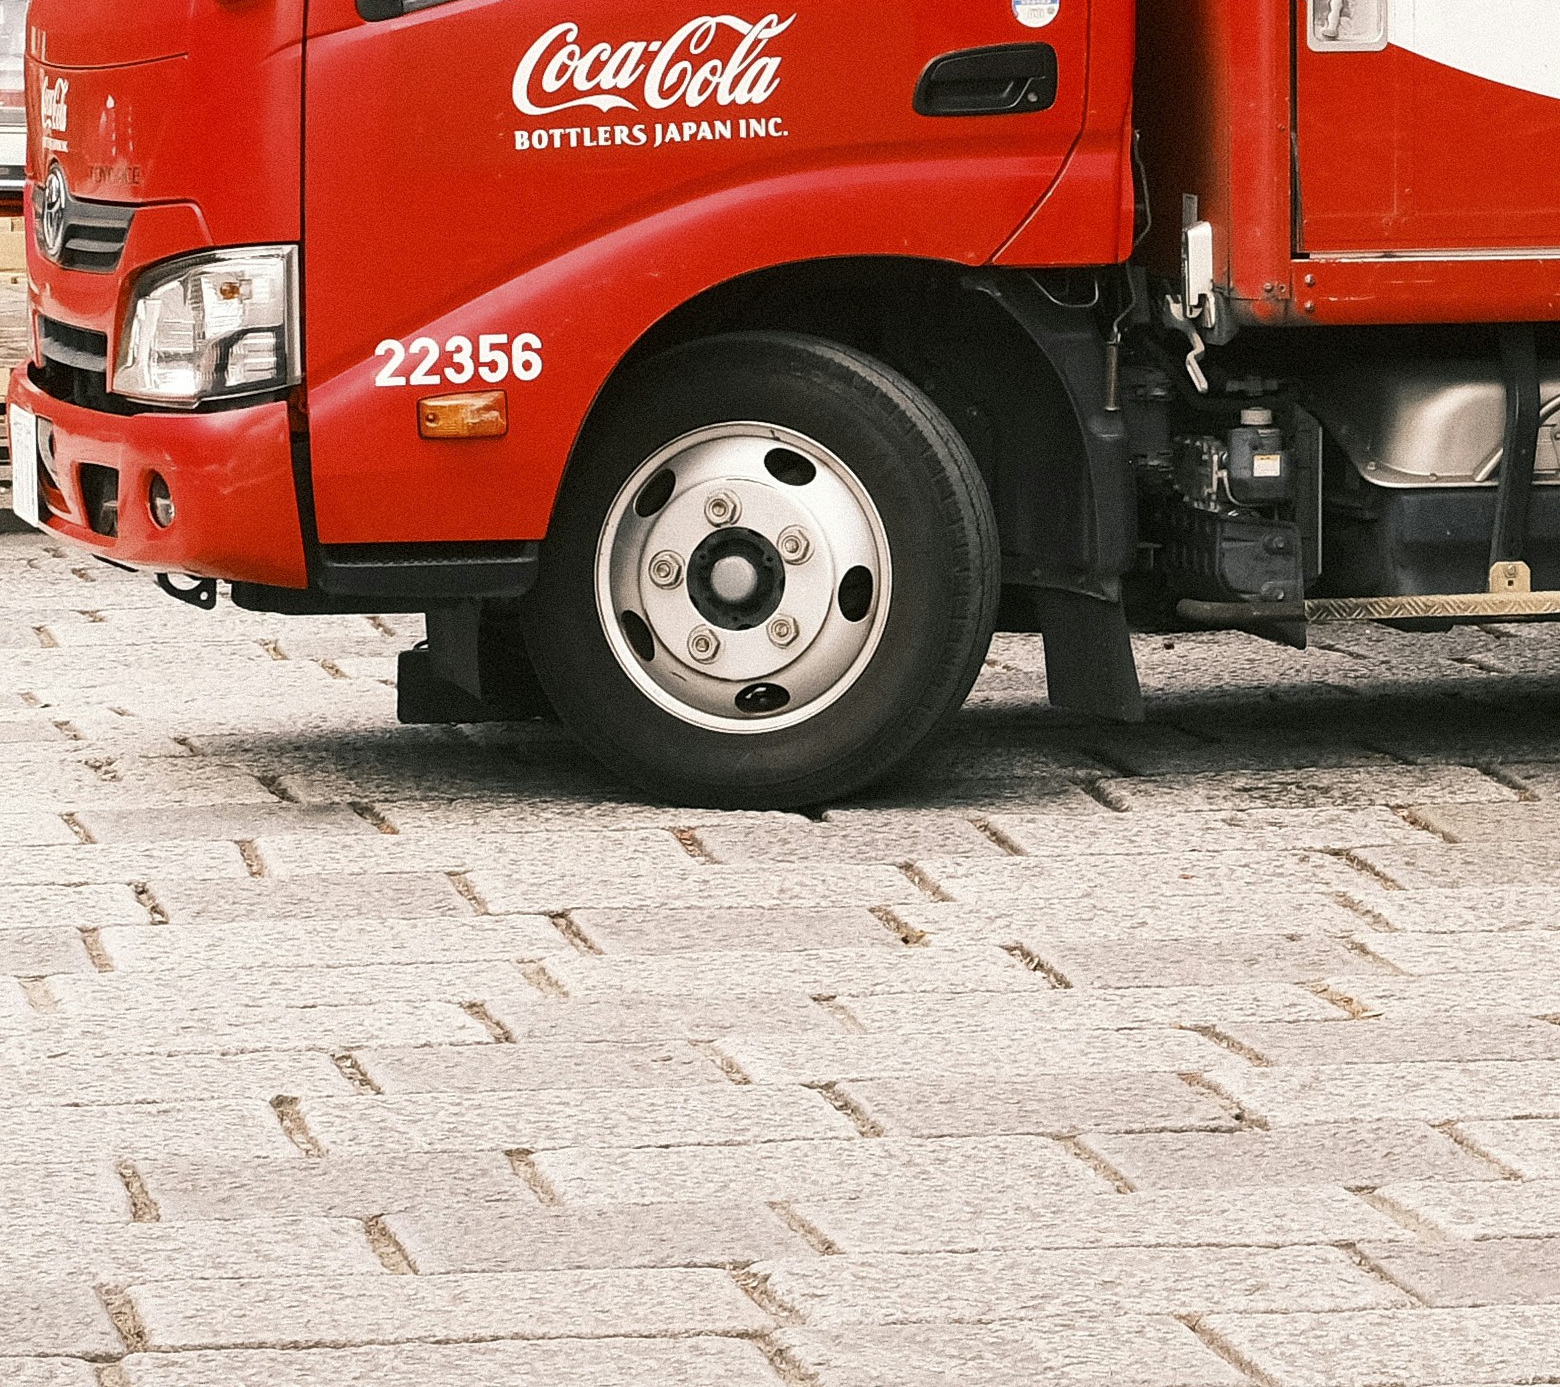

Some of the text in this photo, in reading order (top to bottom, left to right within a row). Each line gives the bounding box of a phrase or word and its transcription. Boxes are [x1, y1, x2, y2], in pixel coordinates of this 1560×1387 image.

[512, 12, 797, 116] Coca-Cola
[513, 117, 789, 150] BOTTLERS JAPAN INC.
[374, 332, 543, 387] 22356
